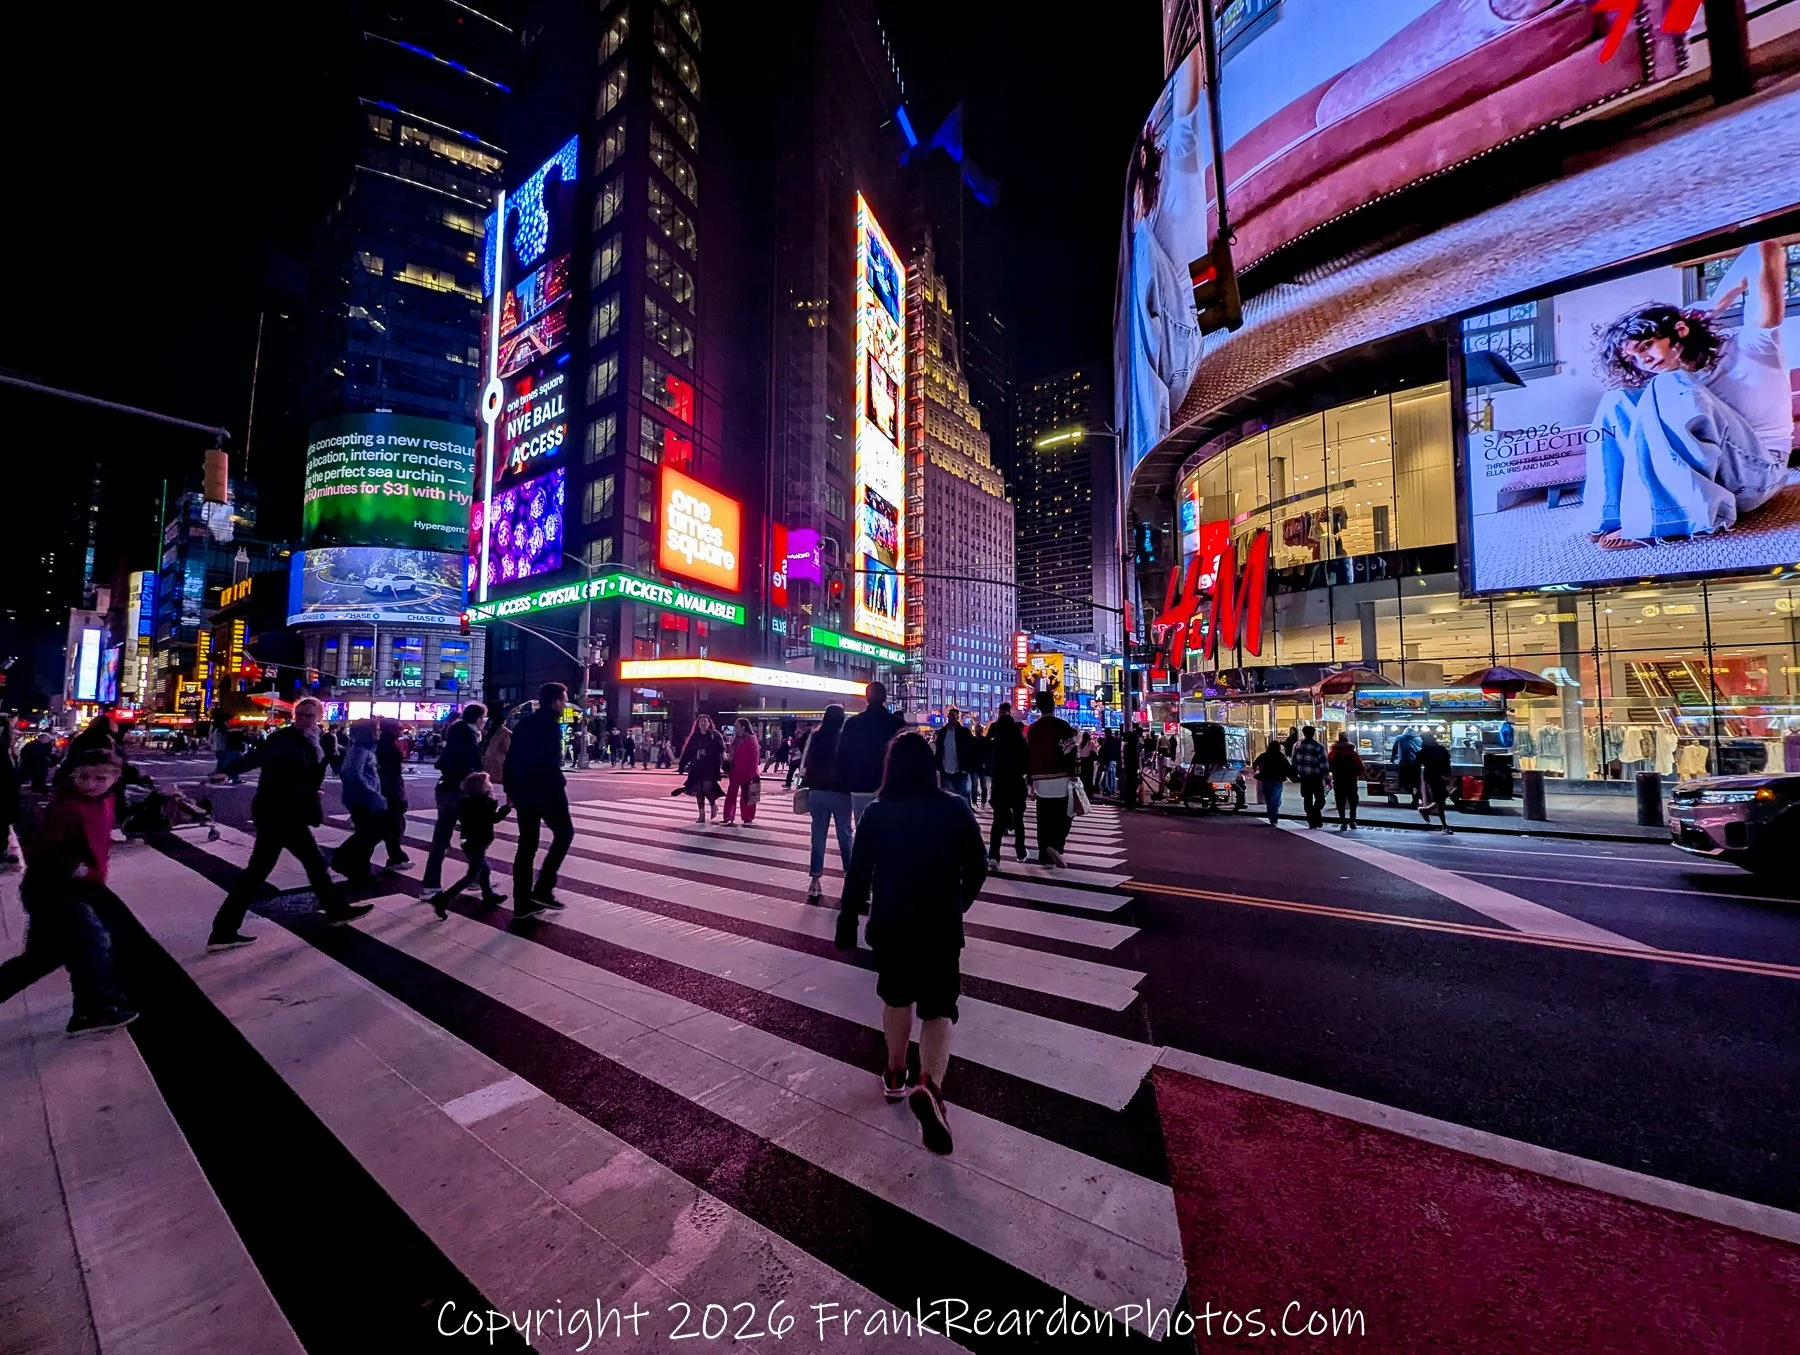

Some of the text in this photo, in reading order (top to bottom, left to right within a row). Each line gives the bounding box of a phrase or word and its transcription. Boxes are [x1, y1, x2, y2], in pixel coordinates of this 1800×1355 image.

[507, 374, 564, 412] one times square
[507, 394, 565, 440] NYE BALL
[316, 432, 374, 450] concepting
[376, 434, 386, 445] a
[388, 435, 420, 448] new
[512, 425, 564, 467] ACCESS
[1484, 421, 1561, 449] S/S2026
[1484, 426, 1617, 460] COLLECTION
[312, 450, 349, 468] location,
[350, 449, 400, 462] interior
[402, 453, 466, 473] renders,
[312, 470, 324, 484] the
[324, 466, 366, 483] perfect
[368, 468, 393, 478] sea
[396, 470, 444, 484] urchin
[1486, 450, 1572, 470] THROUGH THE LENS OF
[1540, 460, 1560, 468] MICA
[317, 484, 358, 498] minutes
[360, 480, 380, 494] for
[382, 480, 409, 496] $31
[412, 485, 446, 500] with
[671, 489, 712, 522] one
[667, 503, 724, 548] times
[666, 529, 735, 571] square
[496, 596, 531, 616] ACCESS
[538, 585, 580, 608] CRYSTAL
[618, 576, 673, 605] TICKETS
[674, 592, 736, 620] AVAILABLE!
[1153, 530, 1270, 670] H&M
[198, 632, 211, 679] NEW VICTORY
[232, 619, 245, 673] NEW VICTORY
[341, 678, 372, 687] CHASE
[385, 679, 422, 687] CHASE
